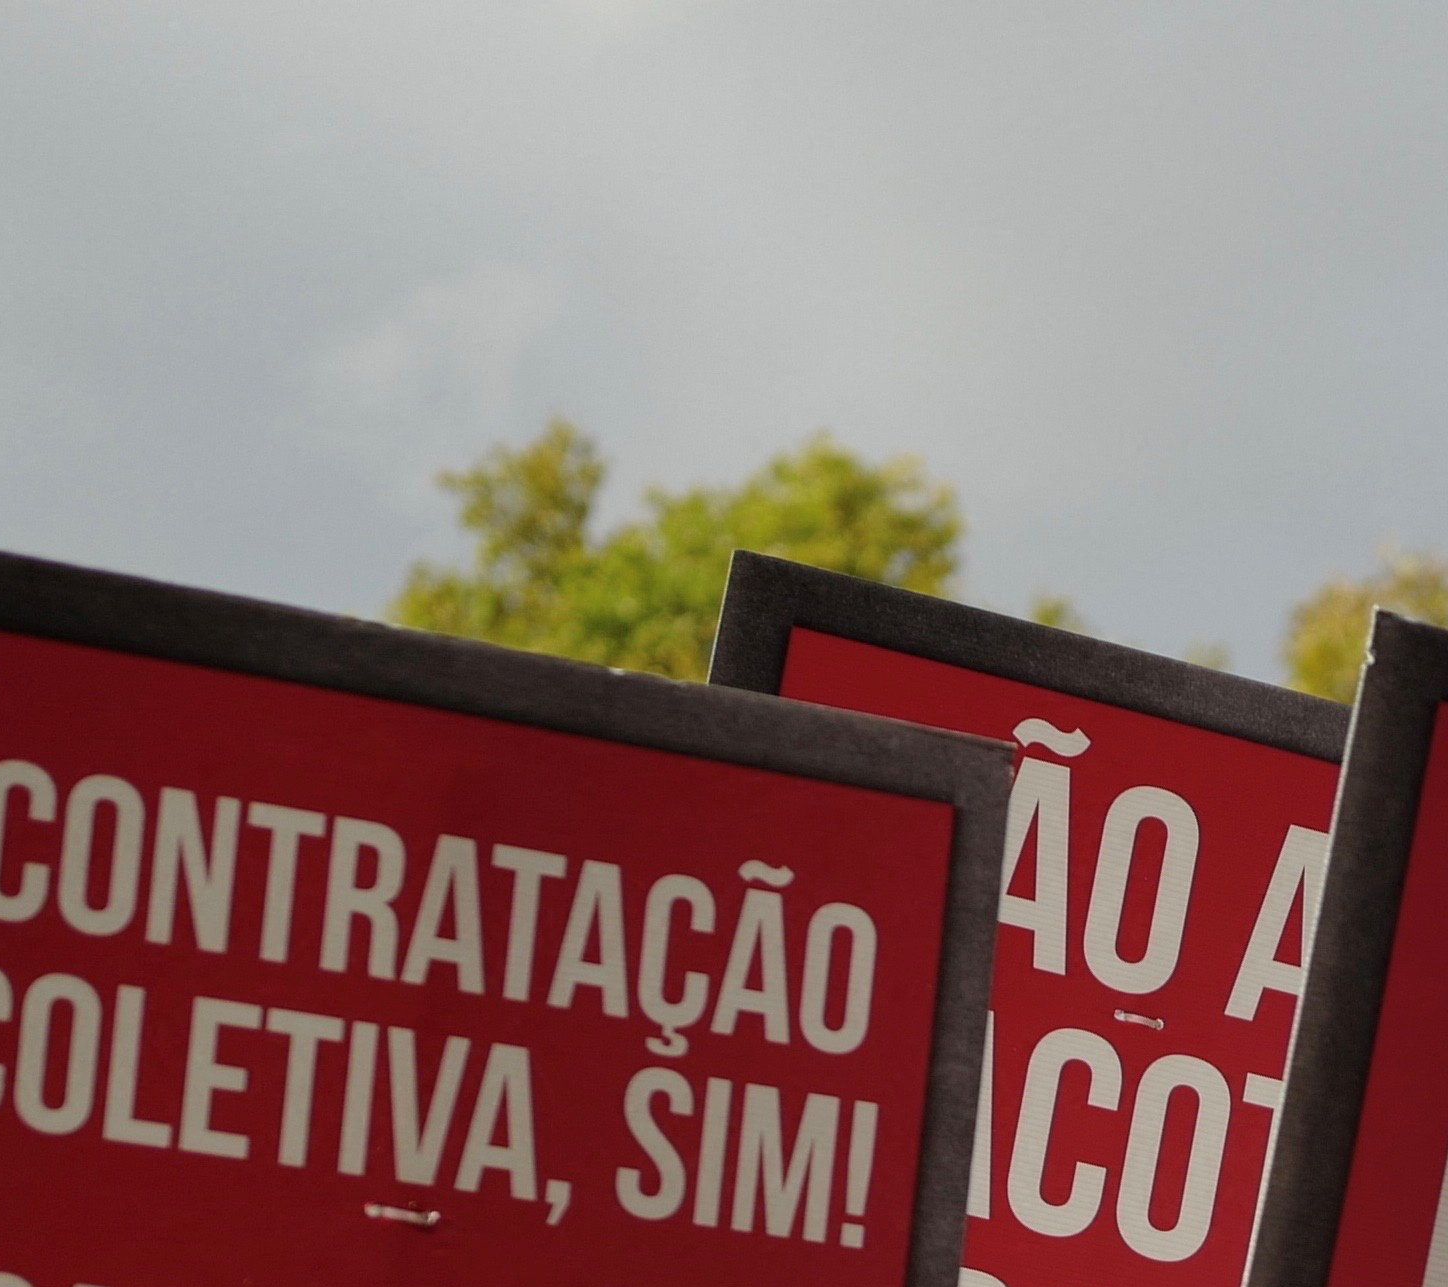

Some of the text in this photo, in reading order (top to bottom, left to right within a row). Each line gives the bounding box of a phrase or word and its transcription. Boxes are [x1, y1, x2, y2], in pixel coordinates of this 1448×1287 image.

[997, 717, 1334, 1022] ÃO A
[616, 1066, 879, 1250] SIM!
